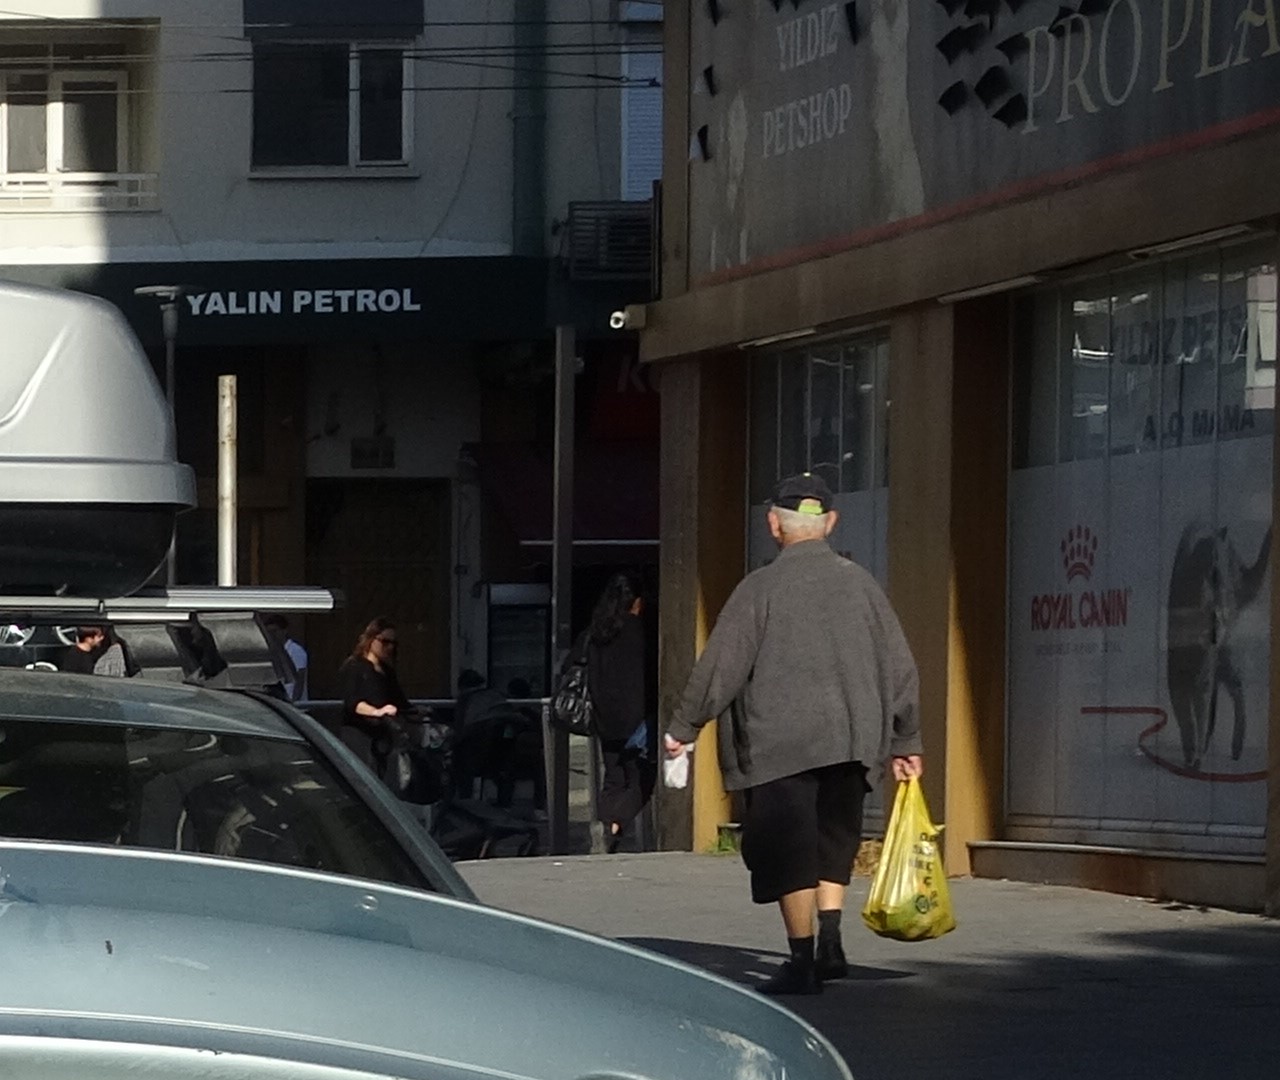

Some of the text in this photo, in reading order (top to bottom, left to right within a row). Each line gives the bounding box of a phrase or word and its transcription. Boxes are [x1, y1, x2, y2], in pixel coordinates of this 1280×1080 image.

[776, 4, 839, 72] YILDIZ
[762, 83, 852, 158] PETSHOP
[187, 287, 421, 316] YALIN PETROL
[1031, 588, 1128, 632] ROYAL CANIN
